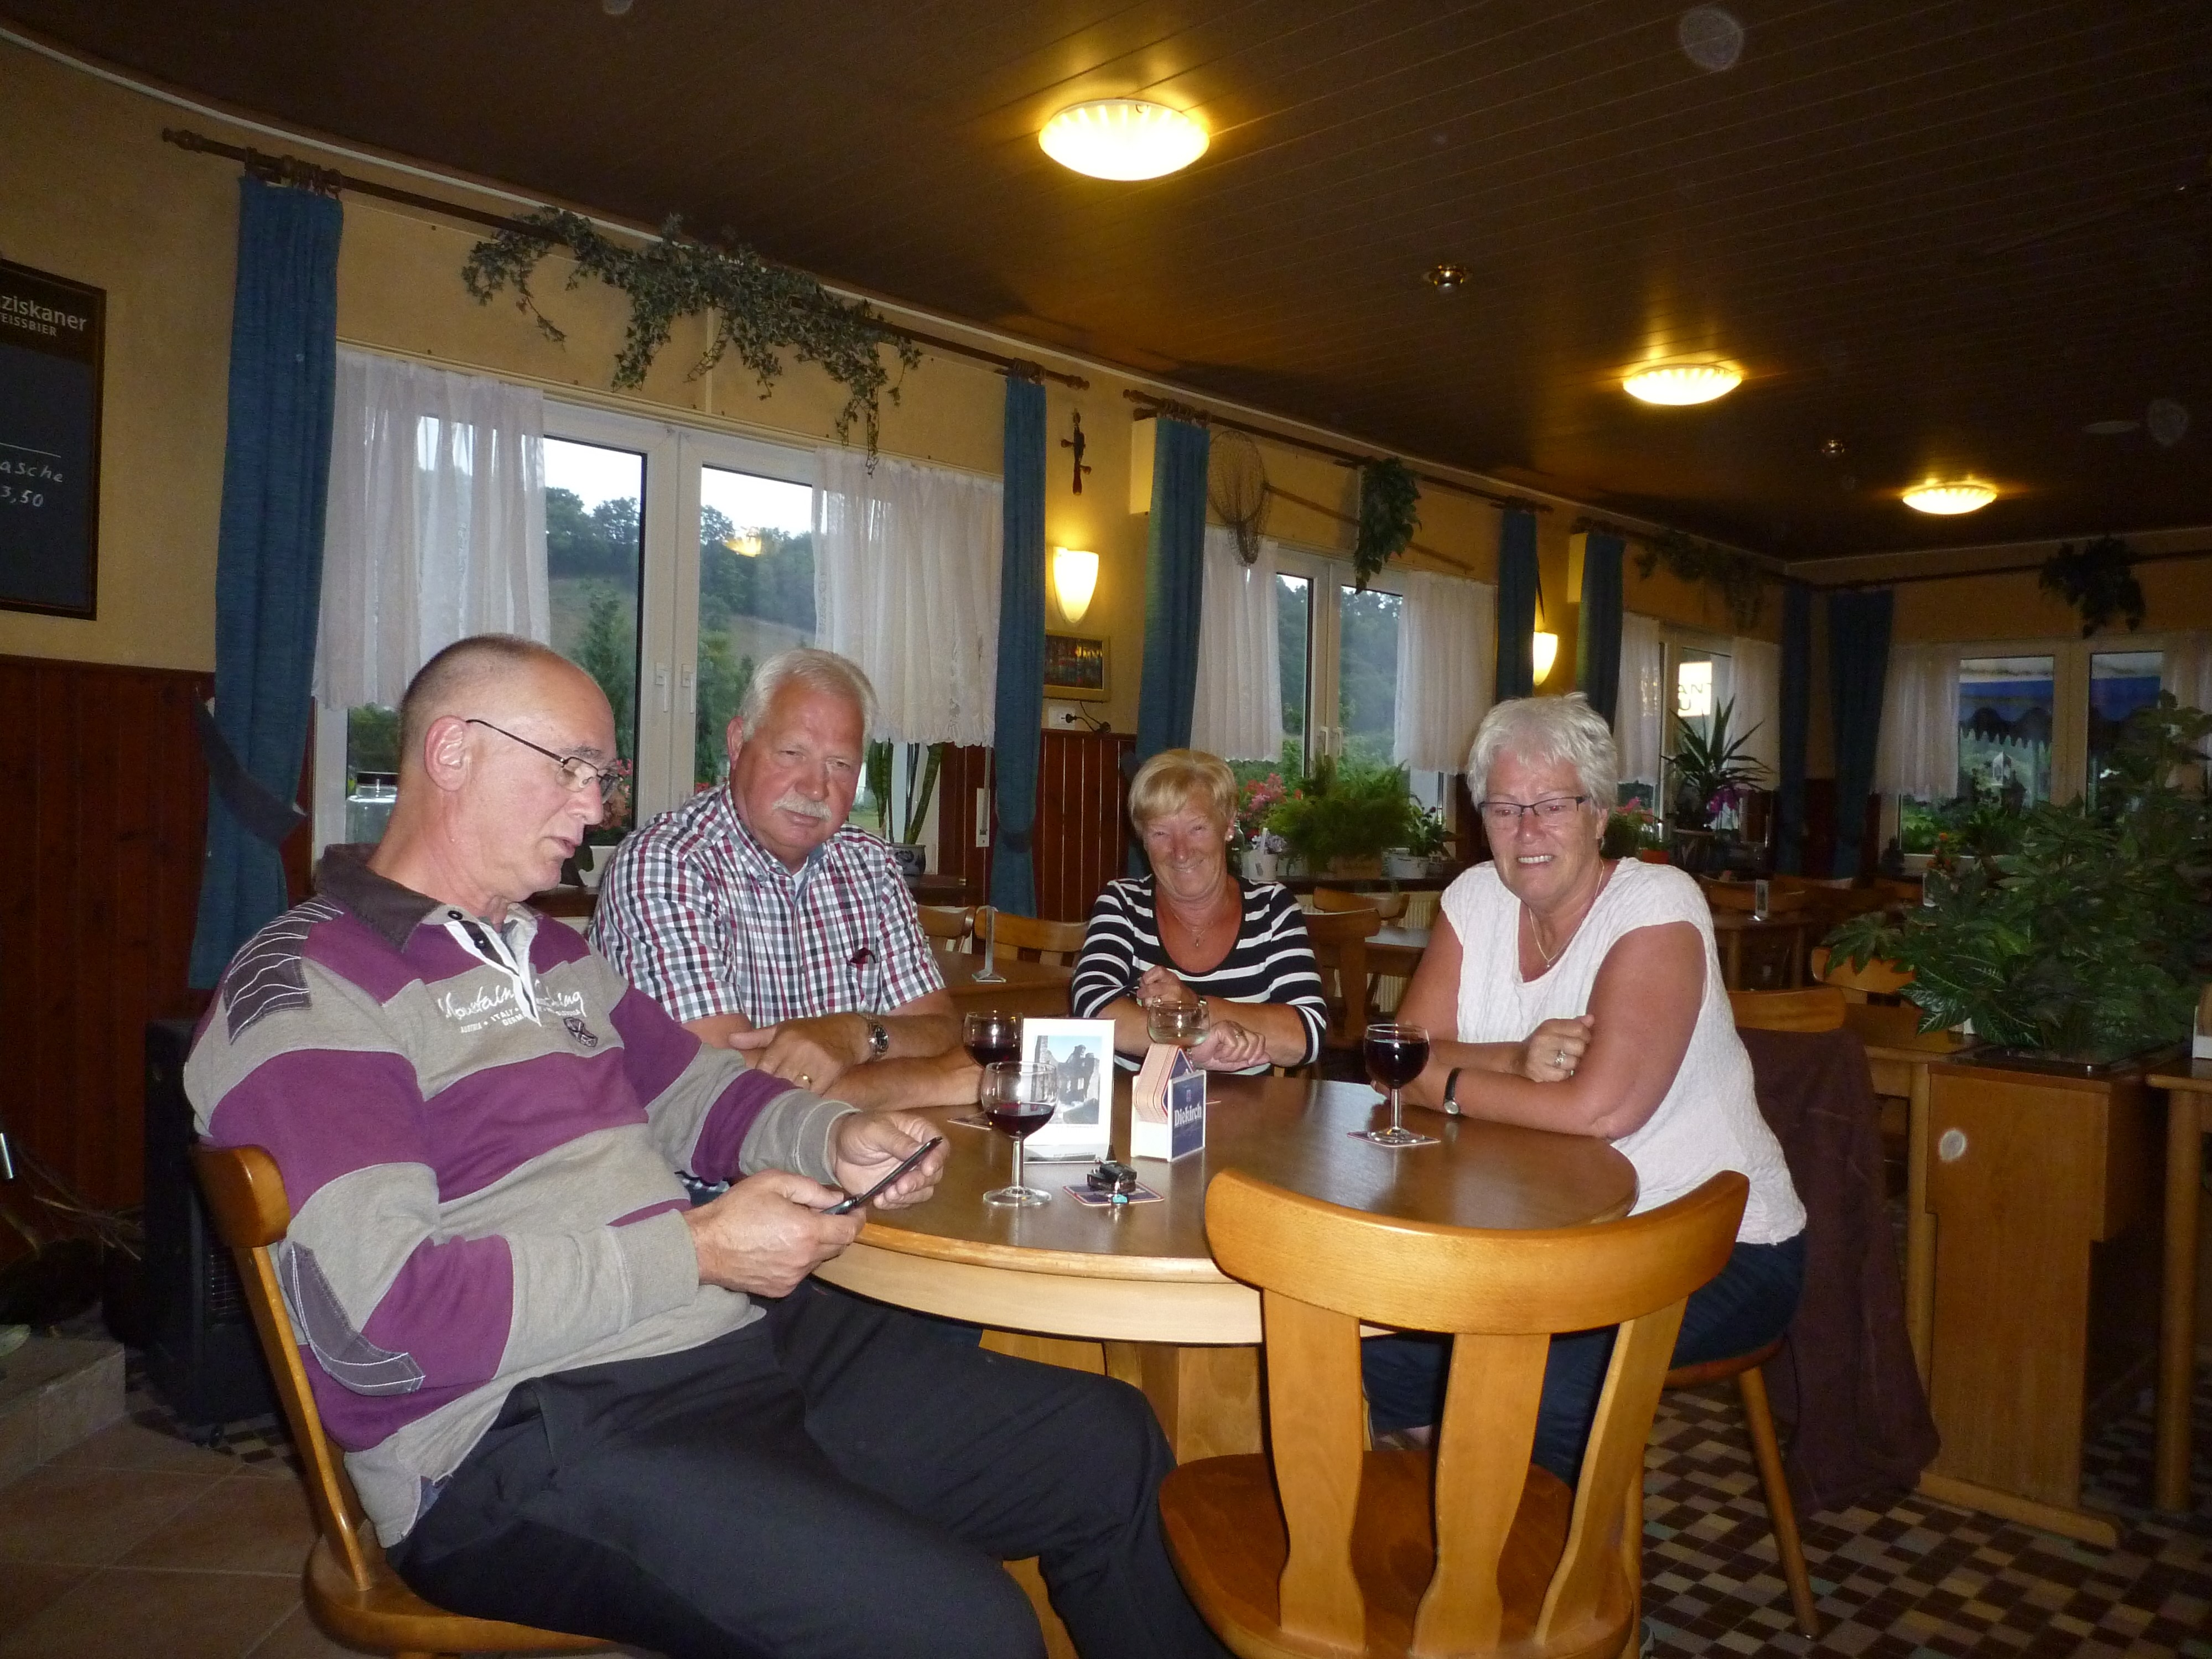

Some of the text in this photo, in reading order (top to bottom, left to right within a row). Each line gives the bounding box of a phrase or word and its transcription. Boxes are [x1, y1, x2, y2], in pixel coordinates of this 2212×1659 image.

[0, 312, 56, 336] EISSBIER
[2, 295, 86, 331] ziskaner
[1, 486, 44, 507] 3,50
[490, 1008, 513, 1021] ITALY
[501, 1013, 525, 1026] GERM
[1174, 1101, 1202, 1127] Diekirch
